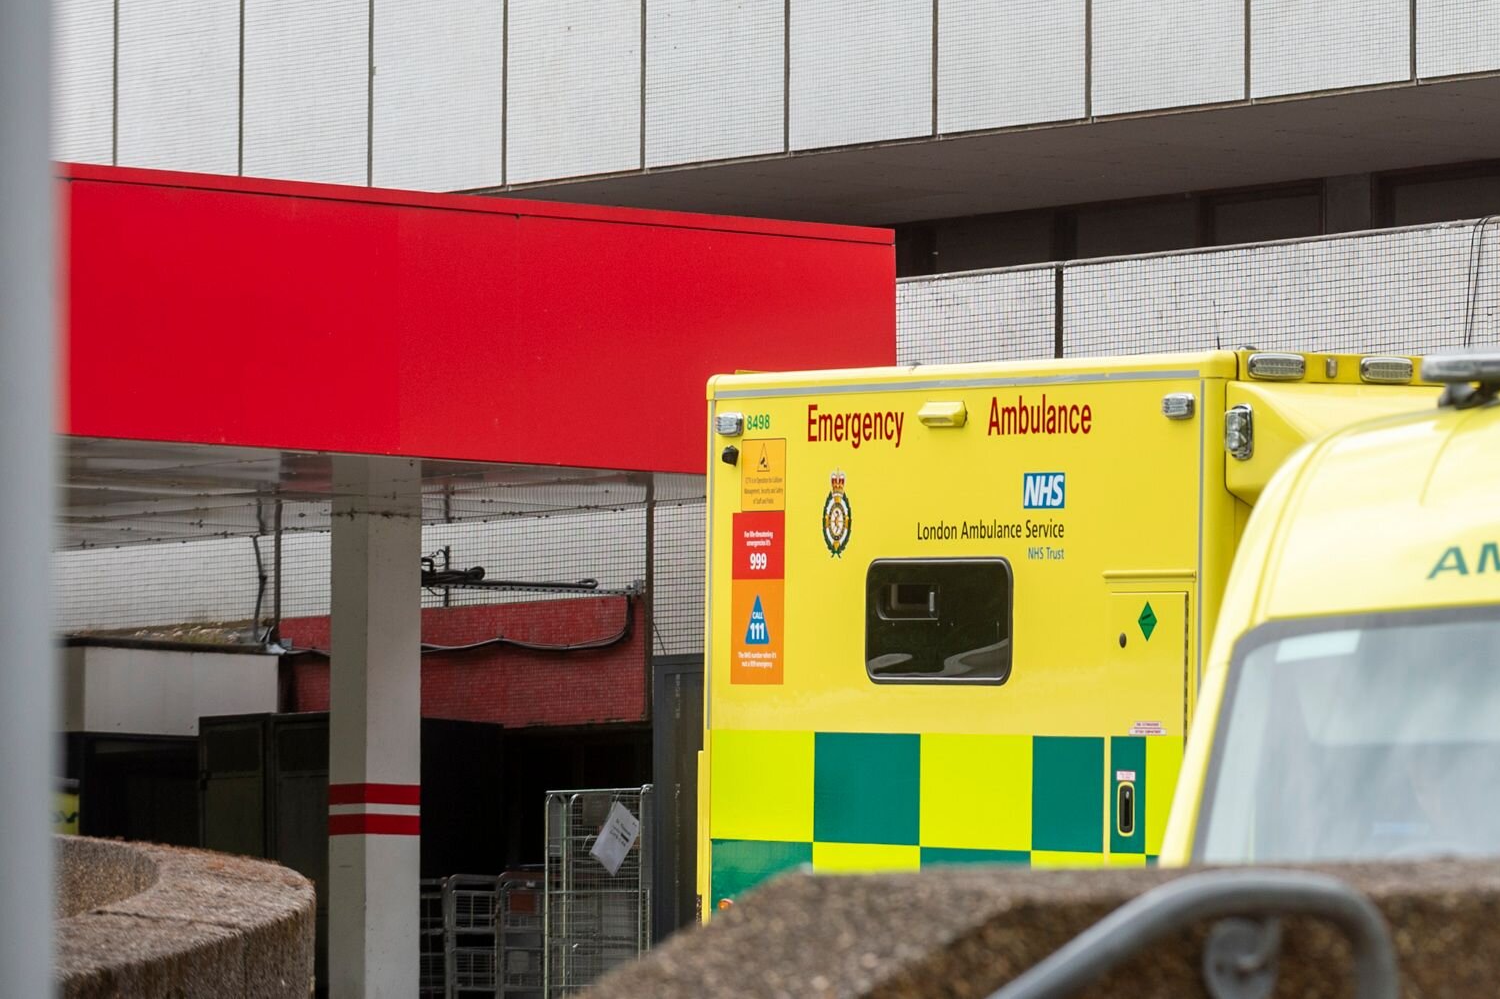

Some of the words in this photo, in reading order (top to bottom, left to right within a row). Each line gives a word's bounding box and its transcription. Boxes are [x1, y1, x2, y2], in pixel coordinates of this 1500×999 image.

[747, 414, 770, 431] 8498
[808, 404, 904, 449] Emergency
[988, 394, 1092, 436] Ambulance
[1024, 474, 1065, 507] NHS
[917, 520, 957, 540] London
[961, 518, 1022, 539] Ambulance
[1025, 518, 1065, 538] Service
[750, 553, 768, 570] 999
[1028, 547, 1044, 560] NHS
[1046, 547, 1065, 559] Trust
[752, 612, 764, 620] CALL
[750, 623, 765, 640] 111
